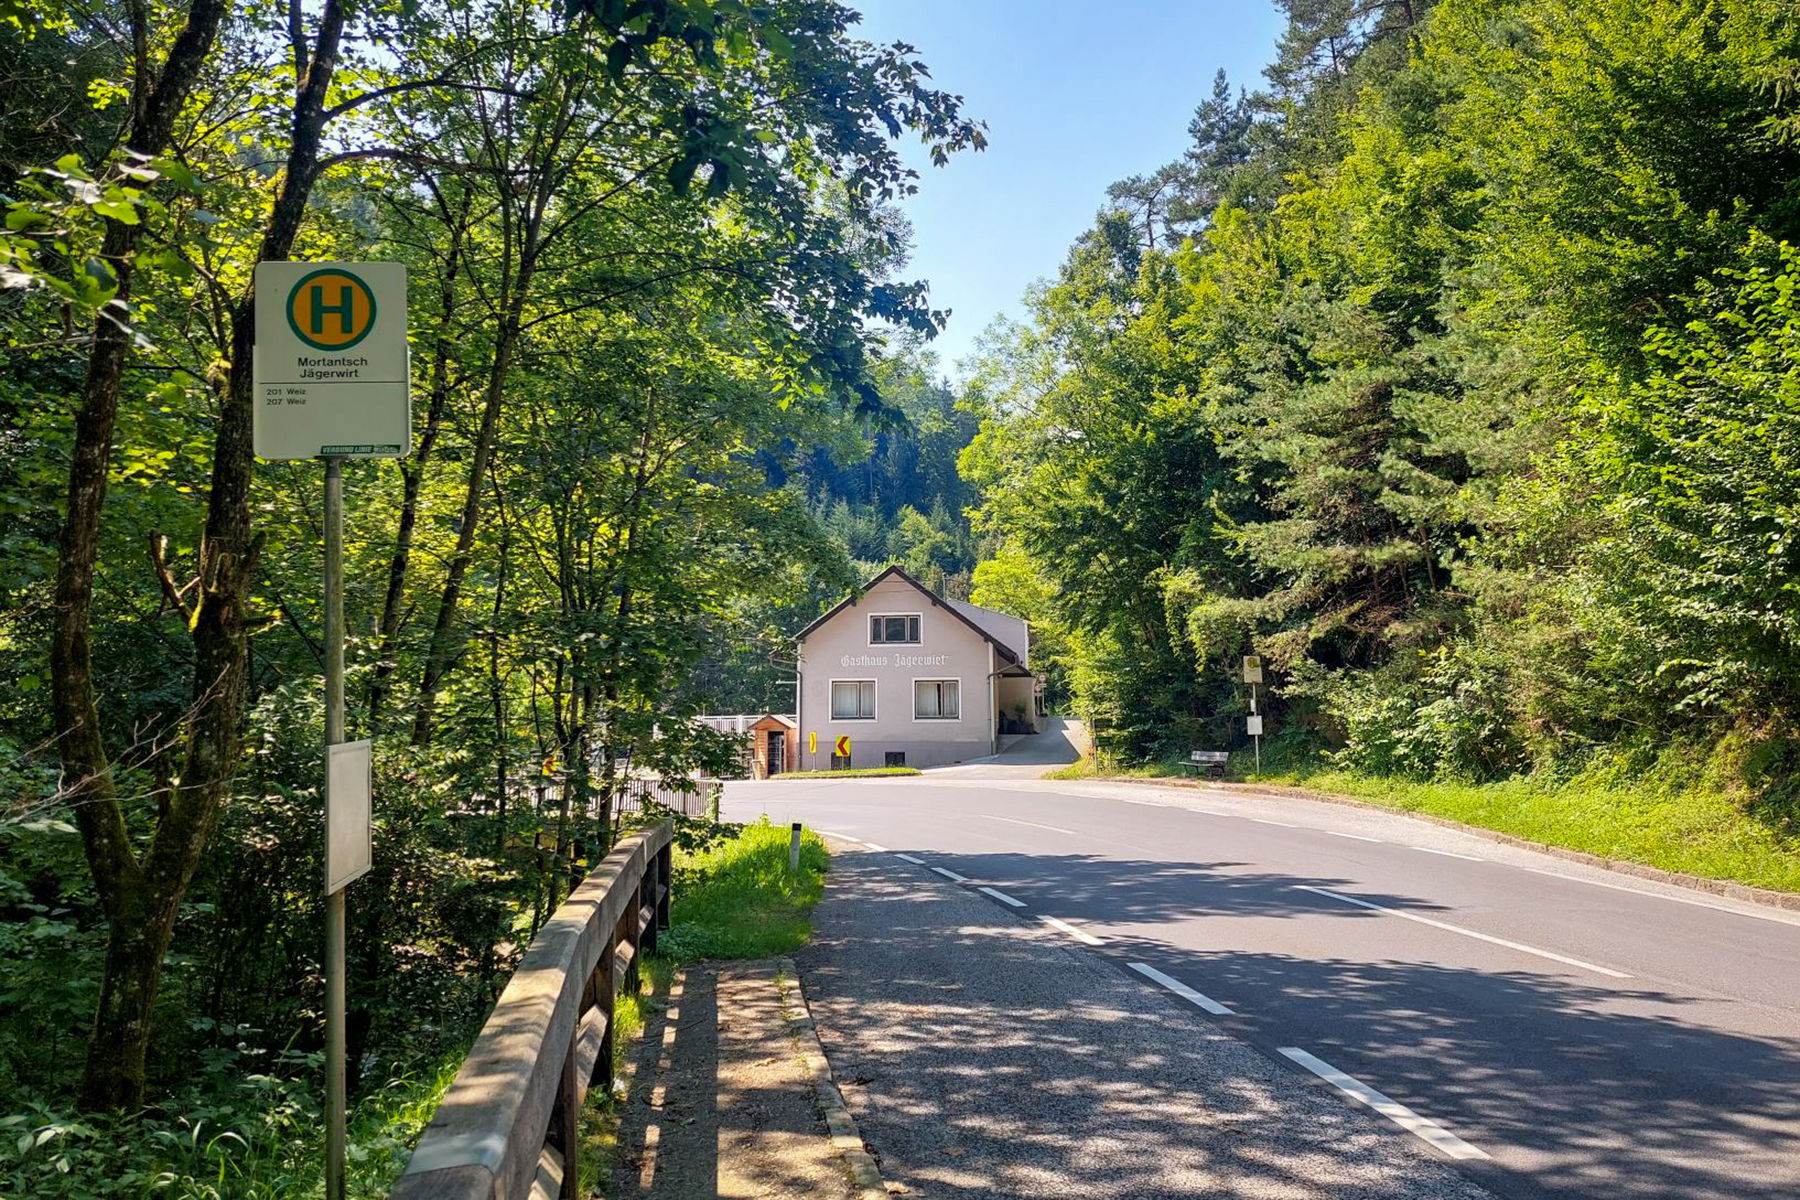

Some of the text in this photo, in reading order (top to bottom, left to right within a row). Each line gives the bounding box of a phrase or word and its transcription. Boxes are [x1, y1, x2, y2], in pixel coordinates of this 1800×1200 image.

[311, 285, 353, 334] H
[298, 357, 368, 367] Mortantsch
[299, 368, 359, 380] Jägerwirt
[266, 388, 282, 396] 201
[266, 398, 282, 406] 207
[840, 653, 946, 668] Gasthaus Jägerwirt
